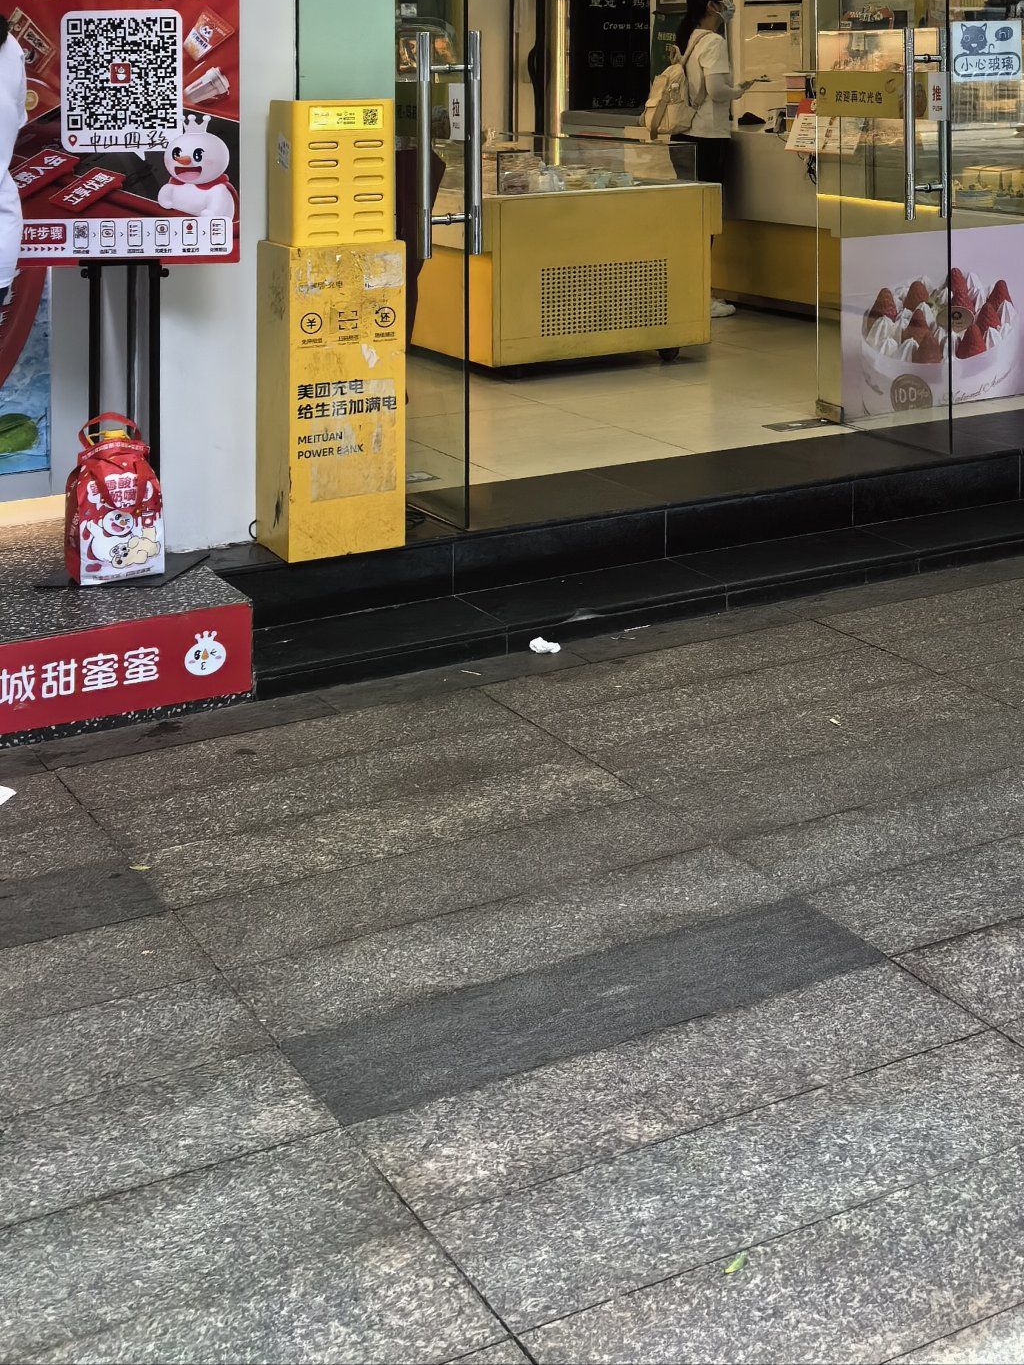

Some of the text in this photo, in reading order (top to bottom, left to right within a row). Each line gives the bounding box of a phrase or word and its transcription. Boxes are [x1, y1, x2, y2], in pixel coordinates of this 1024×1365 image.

[961, 56, 1014, 72] 小心玻璃
[932, 85, 942, 101] 推
[14, 155, 67, 188] 费入会
[63, 172, 116, 205] 立享优惠
[21, 226, 63, 241] 作步骤
[297, 379, 364, 401] 美团充电
[297, 396, 397, 420] 给生活加满电
[297, 431, 343, 446] MEITUAN
[297, 447, 334, 460] POWER
[0, 646, 160, 705] 城甜蜜蜜
